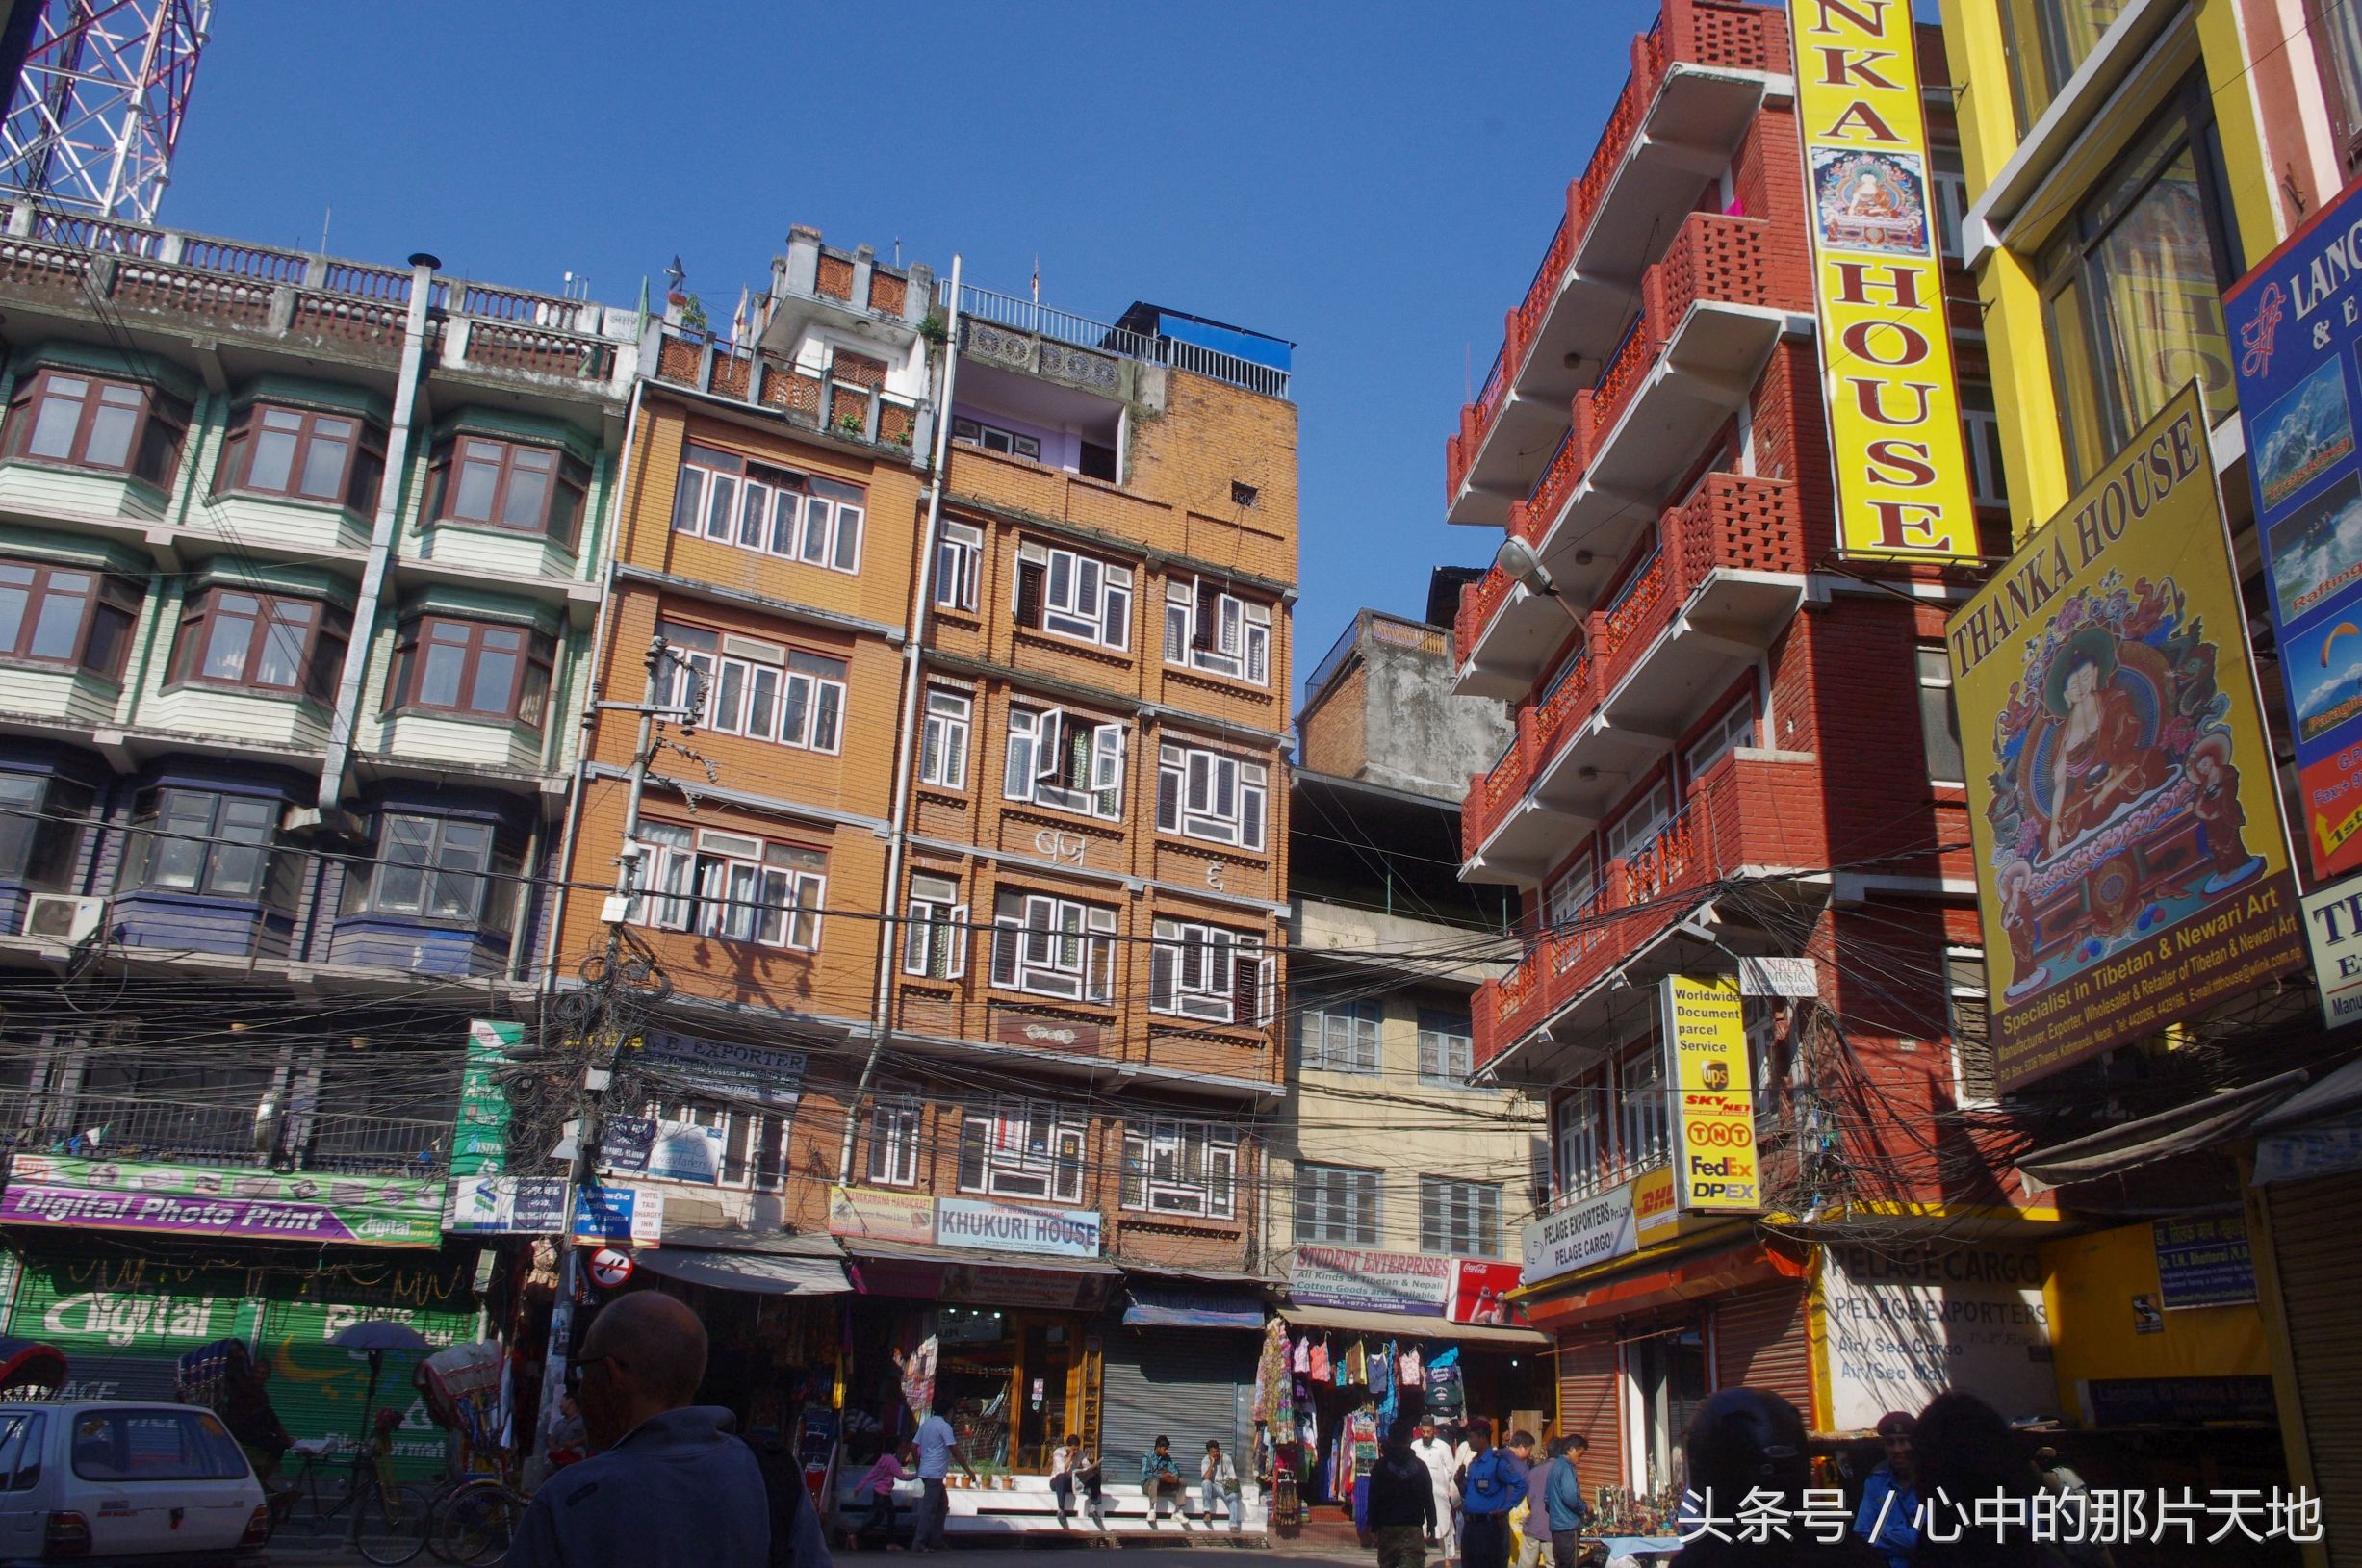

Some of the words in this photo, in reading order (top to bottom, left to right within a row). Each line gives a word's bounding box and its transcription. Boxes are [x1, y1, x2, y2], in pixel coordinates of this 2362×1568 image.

[2312, 320, 2331, 351] &
[1829, 262, 1952, 553] HOUSE
[2268, 437, 2350, 501] Trekking
[1951, 533, 2075, 679] THANKA
[2073, 409, 2201, 571] HOUSE
[2003, 988, 2071, 1036] Specialist
[2074, 982, 2090, 1001] in
[2092, 950, 2154, 990] Tibetan
[2159, 938, 2172, 960] &
[2176, 902, 2243, 952] Newari
[2246, 887, 2279, 920] Art
[1675, 988, 1740, 1002] Worldwide
[1998, 1031, 2048, 1061] Manufacturer,
[2048, 1015, 2084, 1041] Exporter,
[2084, 992, 2131, 1023] Wholesaler
[2132, 984, 2142, 1002] &
[2141, 971, 2176, 997] Retailer
[2179, 961, 2189, 981] of
[2190, 947, 2228, 975] Tibetan
[2229, 938, 2239, 959] &
[2239, 920, 2277, 954] Newari
[2278, 914, 2298, 936] Art
[1677, 1006, 1740, 1019] Document
[1679, 1024, 1717, 1036] parcel
[693, 1041, 803, 1070] EXPORTER
[1680, 1040, 1727, 1053] Service
[1703, 1068, 1728, 1089] ups
[1691, 1124, 1749, 1144] TNT
[1691, 1155, 1753, 1178] FedEx
[1642, 1184, 1675, 1214] DHL
[1693, 1182, 1756, 1199] DPEX
[14, 1190, 135, 1221] Digital
[135, 1198, 235, 1226] Photo
[240, 1205, 325, 1231] Print
[1544, 1219, 1569, 1246] PELAGE
[1570, 1202, 1610, 1236] EXPORTERS
[941, 1210, 1029, 1240] KHUKURI
[1035, 1218, 1097, 1247] HOUSE
[1298, 1247, 1361, 1272] STUDENT
[1362, 1252, 1450, 1278] ENTERPRISES
[1554, 1242, 1582, 1267] PELAGE
[1584, 1231, 1611, 1257] CARGO
[1831, 1247, 1942, 1281] PELAGE
[1943, 1250, 2041, 1285] CARGO
[1297, 1271, 1311, 1279] All
[1315, 1272, 1345, 1282] Kinds
[1348, 1272, 1357, 1283] of
[1360, 1275, 1399, 1287] Tibetan
[1401, 1278, 1409, 1287] &
[1412, 1279, 1443, 1292] Nepali
[1297, 1281, 1334, 1292] Cotton
[1336, 1284, 1368, 1295] Goods
[1371, 1287, 1388, 1296] are
[1390, 1289, 1439, 1300] Available.
[1308, 1292, 1339, 1300] Narsing
[44, 1290, 214, 1348] Digital
[1835, 1297, 1921, 1322] PELAGE
[1924, 1300, 2048, 1325] EXPORTERS
[1876, 1338, 1905, 1354] Sea
[1913, 1338, 1964, 1357] Cargo
